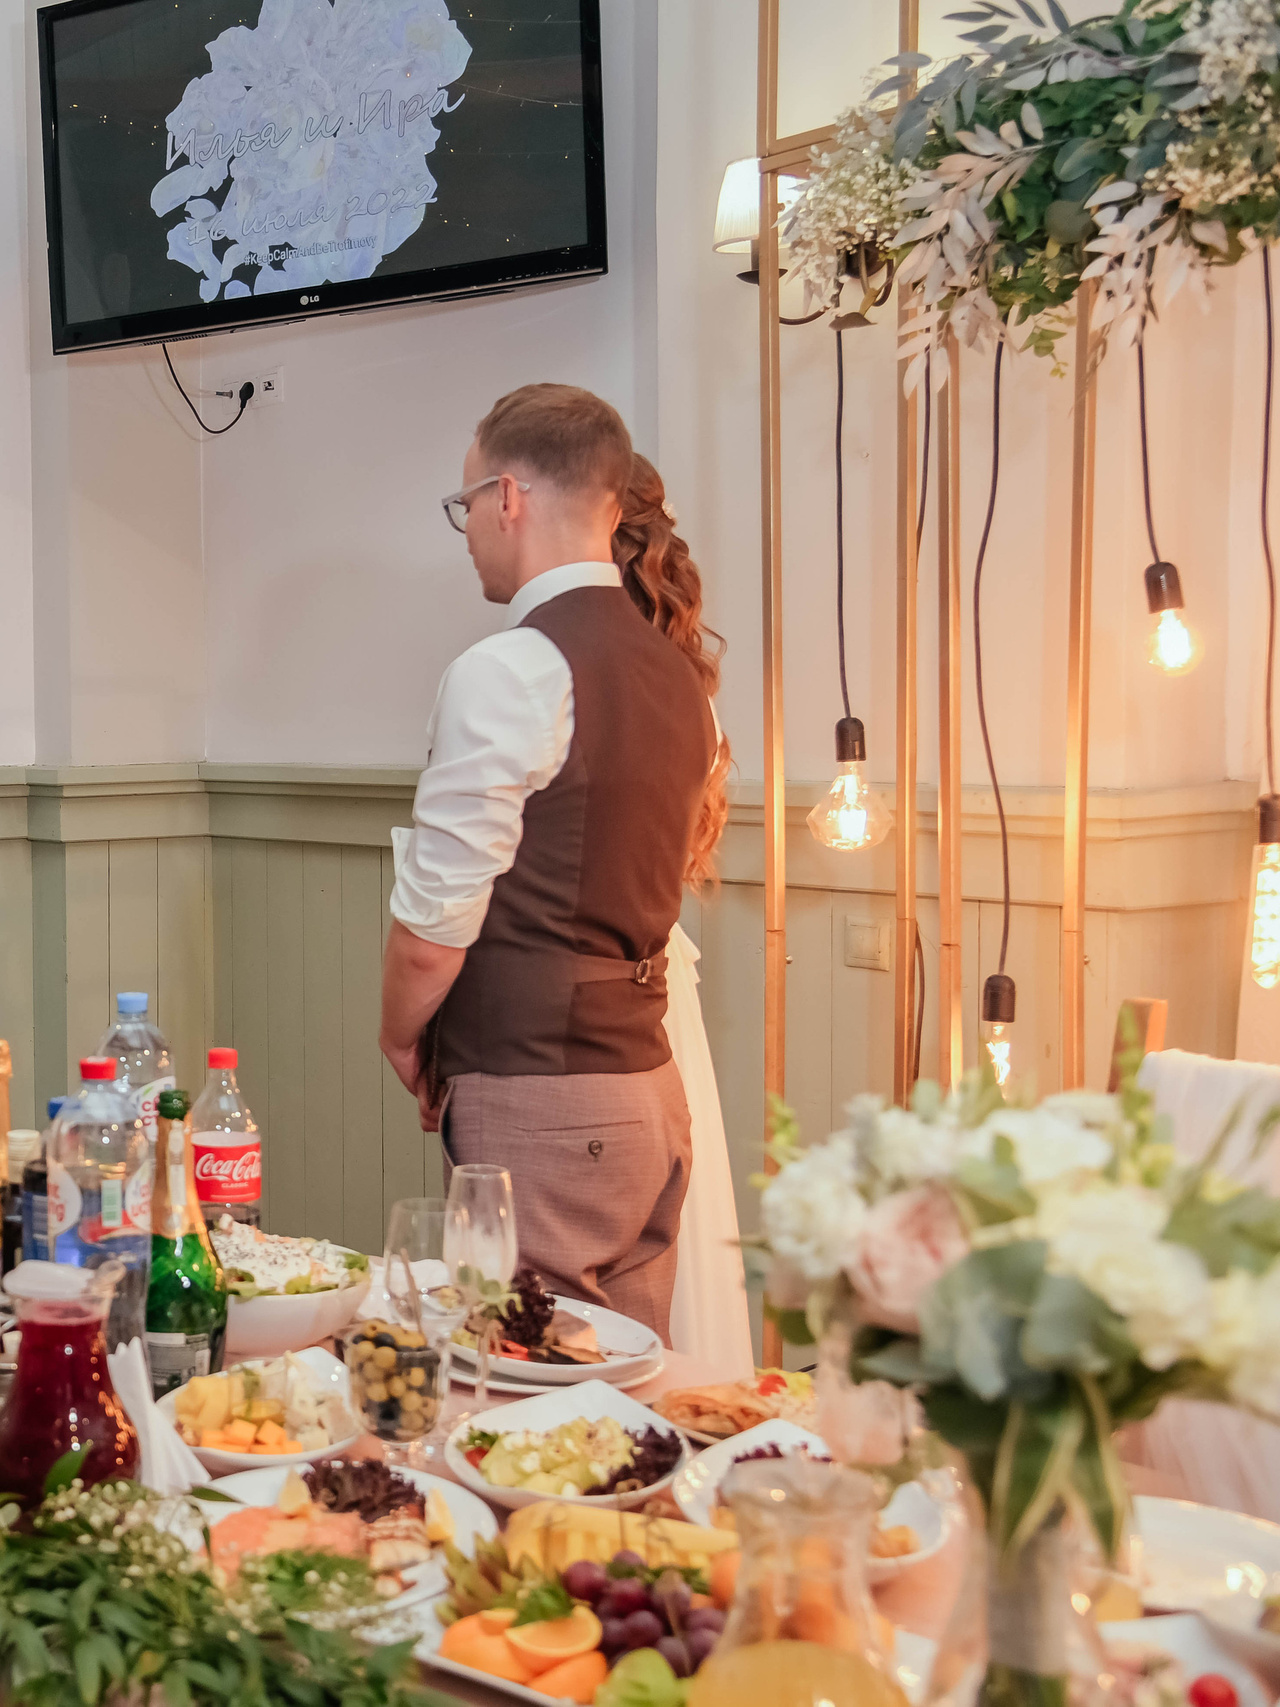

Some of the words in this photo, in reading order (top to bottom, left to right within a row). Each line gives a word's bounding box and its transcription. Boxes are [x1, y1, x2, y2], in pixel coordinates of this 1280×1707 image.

[165, 122, 293, 171] Илья
[304, 114, 345, 143] и
[357, 88, 466, 138] Ира
[187, 216, 228, 247] 16
[241, 206, 337, 237] июля
[344, 184, 438, 221] 2022
